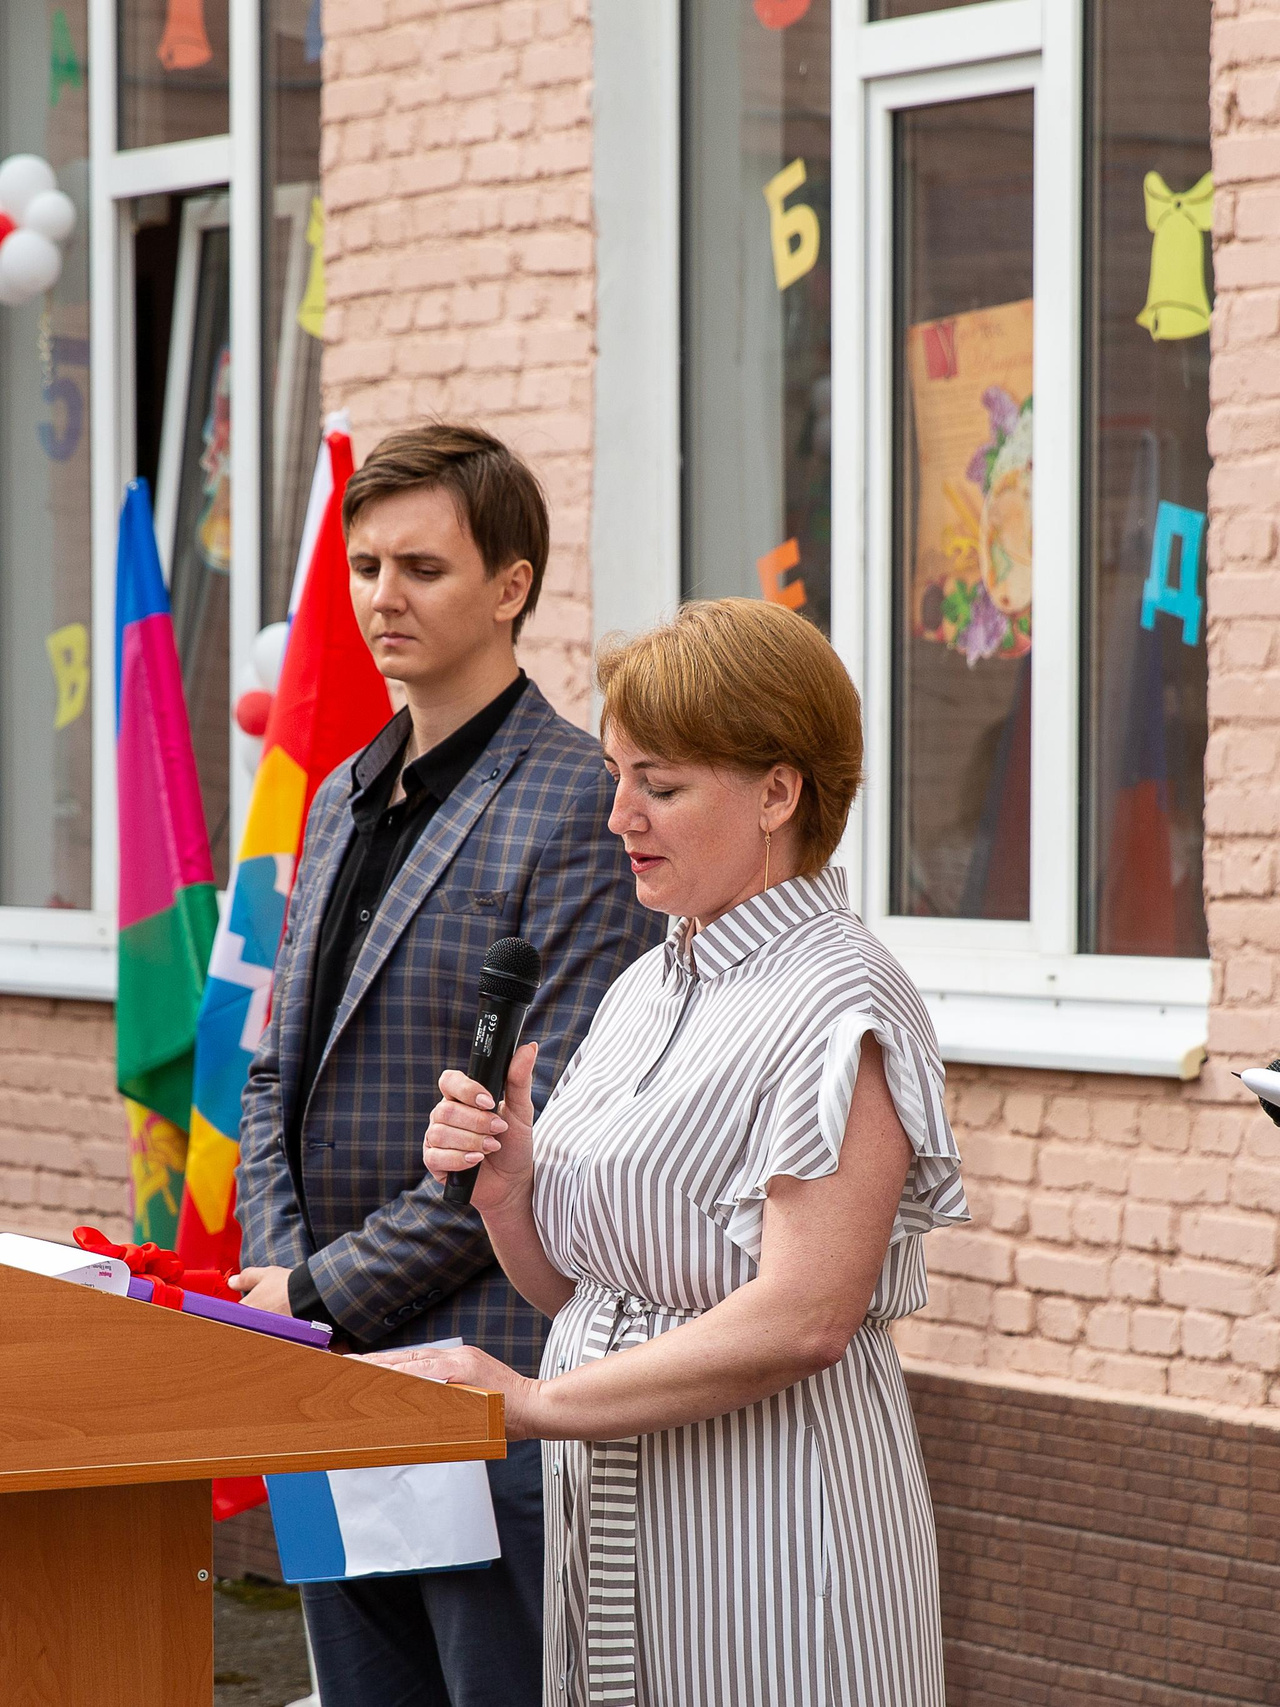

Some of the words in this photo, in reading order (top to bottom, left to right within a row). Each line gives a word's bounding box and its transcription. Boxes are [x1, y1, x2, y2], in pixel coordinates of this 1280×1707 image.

[763, 158, 821, 291] Б
[1140, 500, 1208, 647] Д
[45, 622, 91, 730] В
